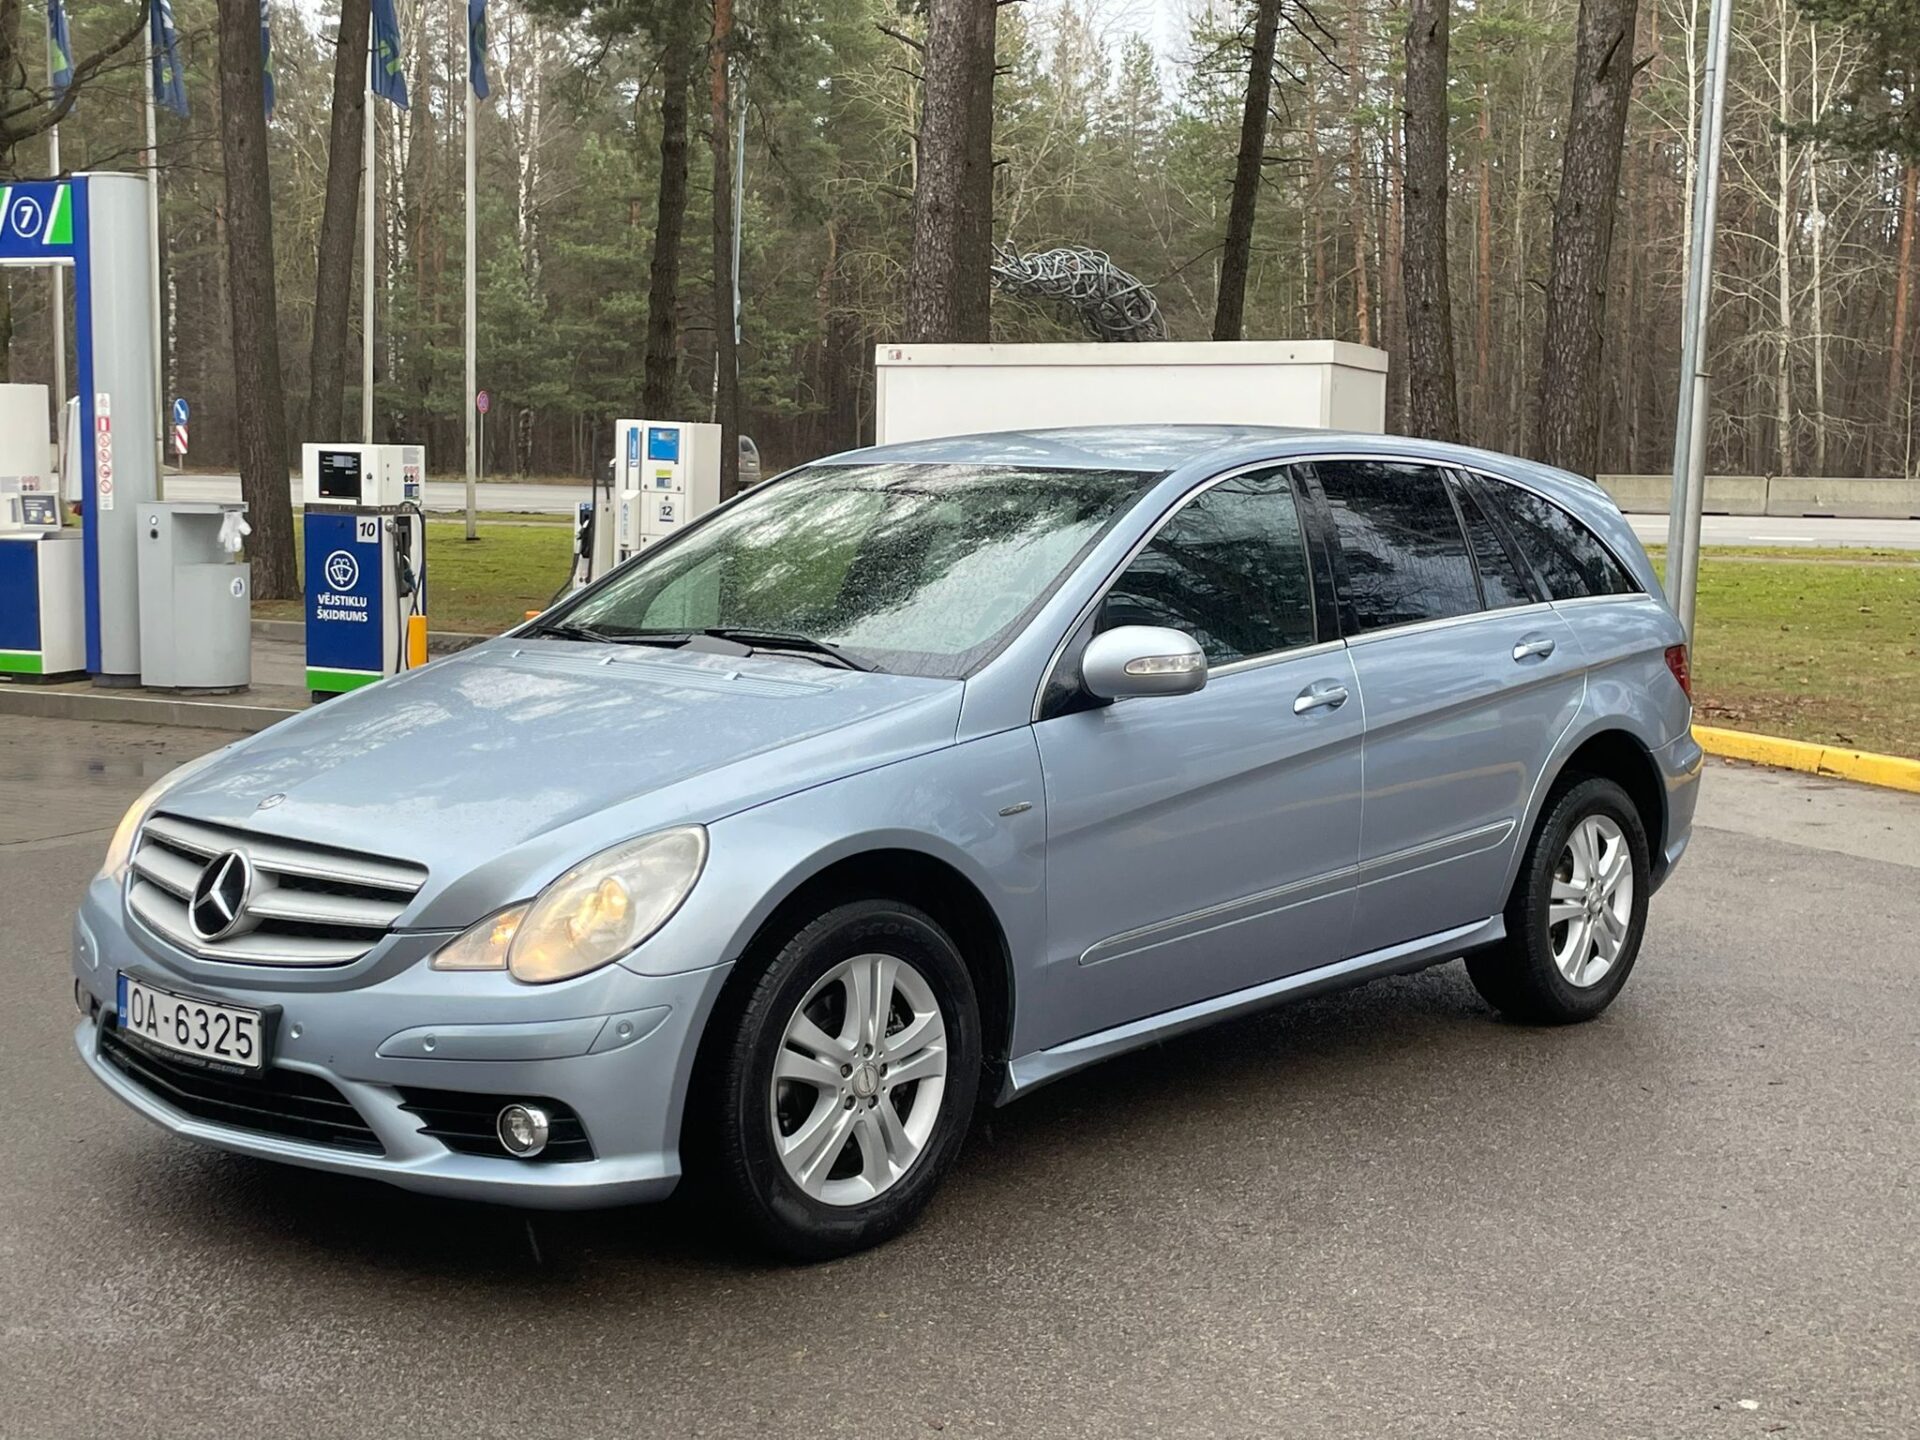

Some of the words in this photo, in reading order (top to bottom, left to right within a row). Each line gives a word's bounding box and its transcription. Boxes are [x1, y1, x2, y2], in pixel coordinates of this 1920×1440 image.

[20, 205, 34, 229] 7
[661, 505, 673, 517] 12
[359, 522, 376, 537] 10
[317, 592, 367, 608] VĒJSTIKLU
[316, 606, 368, 622] ŠĶIDRUMS
[132, 987, 253, 1060] OA-6325
